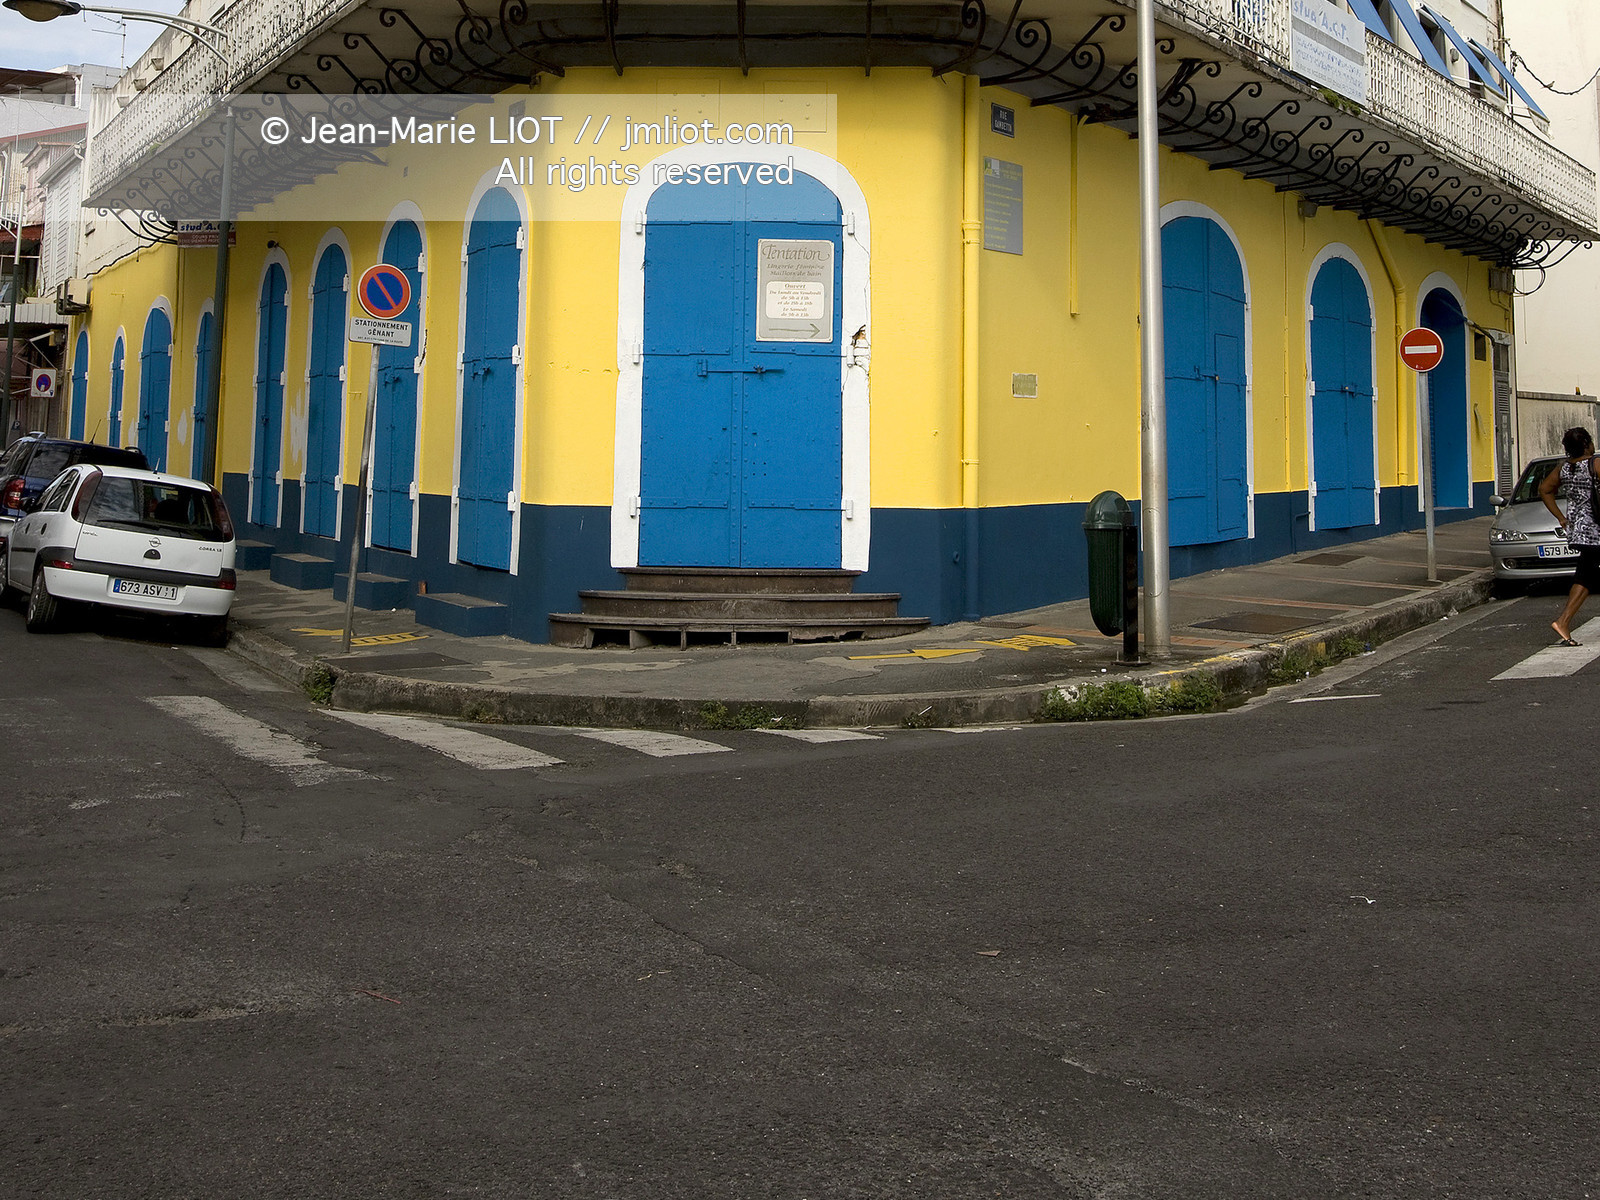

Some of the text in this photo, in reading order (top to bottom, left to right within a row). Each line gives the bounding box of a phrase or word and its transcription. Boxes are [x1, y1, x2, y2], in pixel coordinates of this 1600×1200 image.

[762, 244, 830, 261] Tentation
[355, 319, 408, 331] STATIONNEMENT
[367, 328, 394, 337] GÊNANT
[1545, 546, 1561, 556] 579
[120, 581, 141, 593] 673
[142, 584, 163, 596] ASV
